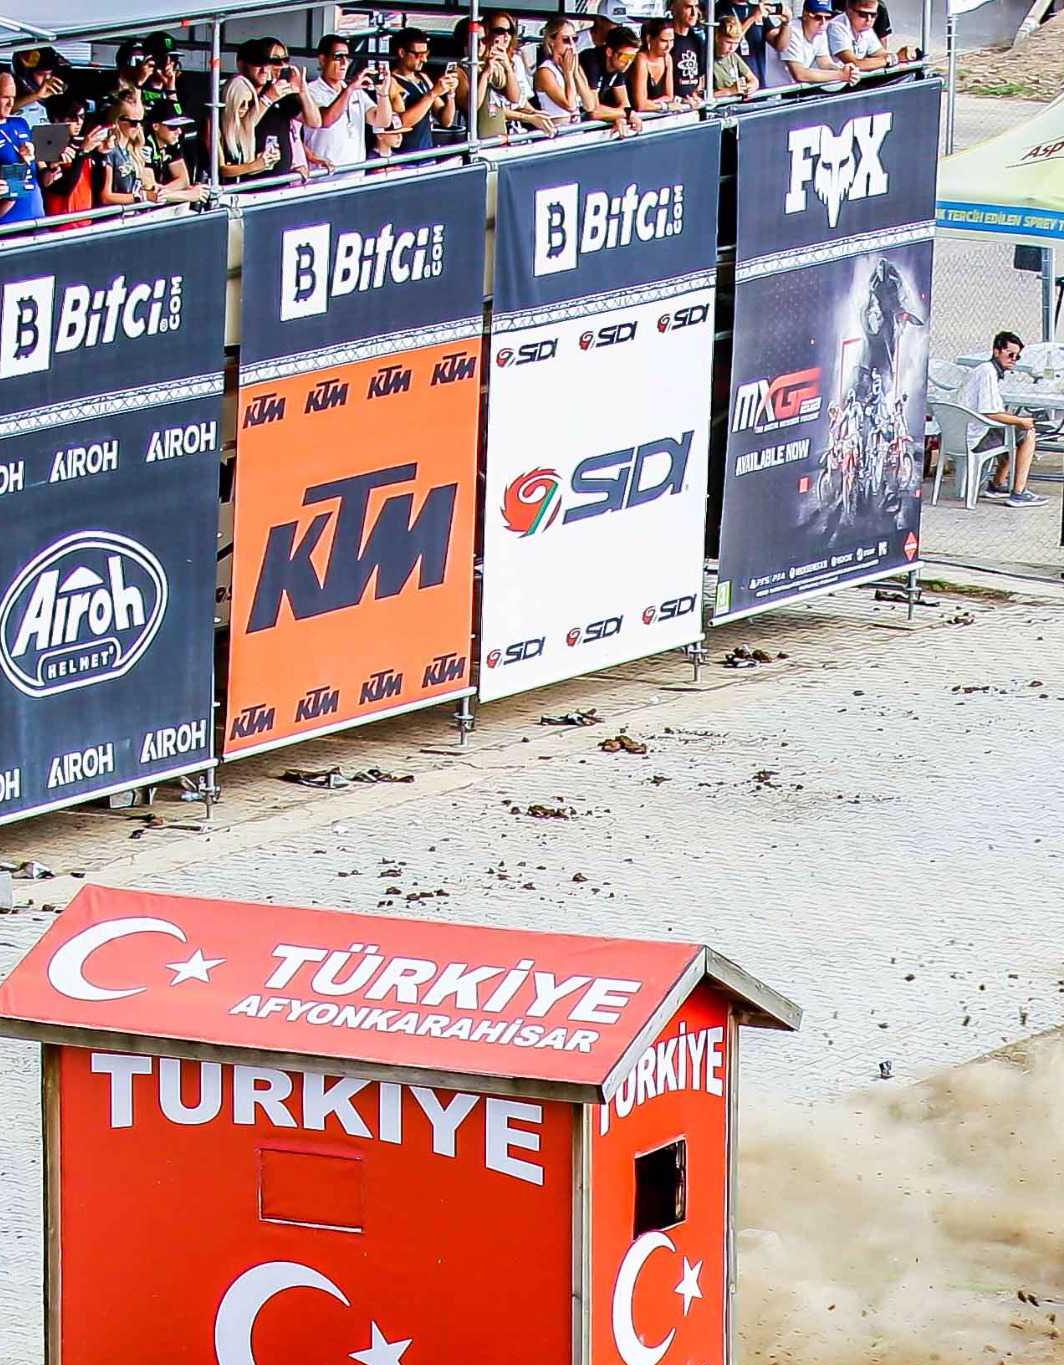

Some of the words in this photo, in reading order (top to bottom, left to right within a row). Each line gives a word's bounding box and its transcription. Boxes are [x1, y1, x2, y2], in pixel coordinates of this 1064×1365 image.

[331, 224, 428, 297] Bitci
[55, 275, 165, 354] Bitci
[243, 393, 286, 429] KTM
[305, 378, 349, 414] KTM
[367, 365, 411, 399] KTM
[431, 352, 476, 387] KTM
[50, 441, 119, 483] AIROH
[146, 421, 217, 462] AIROH
[736, 444, 785, 477] AVAILABLE
[785, 439, 810, 462] NOW
[245, 462, 458, 634] KTM
[11, 556, 146, 658] Airoh
[48, 650, 112, 680] HELMET
[230, 704, 275, 741] KTM
[295, 686, 339, 722] KTM
[360, 669, 402, 705] KTM
[422, 653, 466, 688] KTM
[48, 743, 113, 788] AIROH
[140, 720, 206, 764] AIROH
[264, 943, 641, 1025] TÜRKİYE
